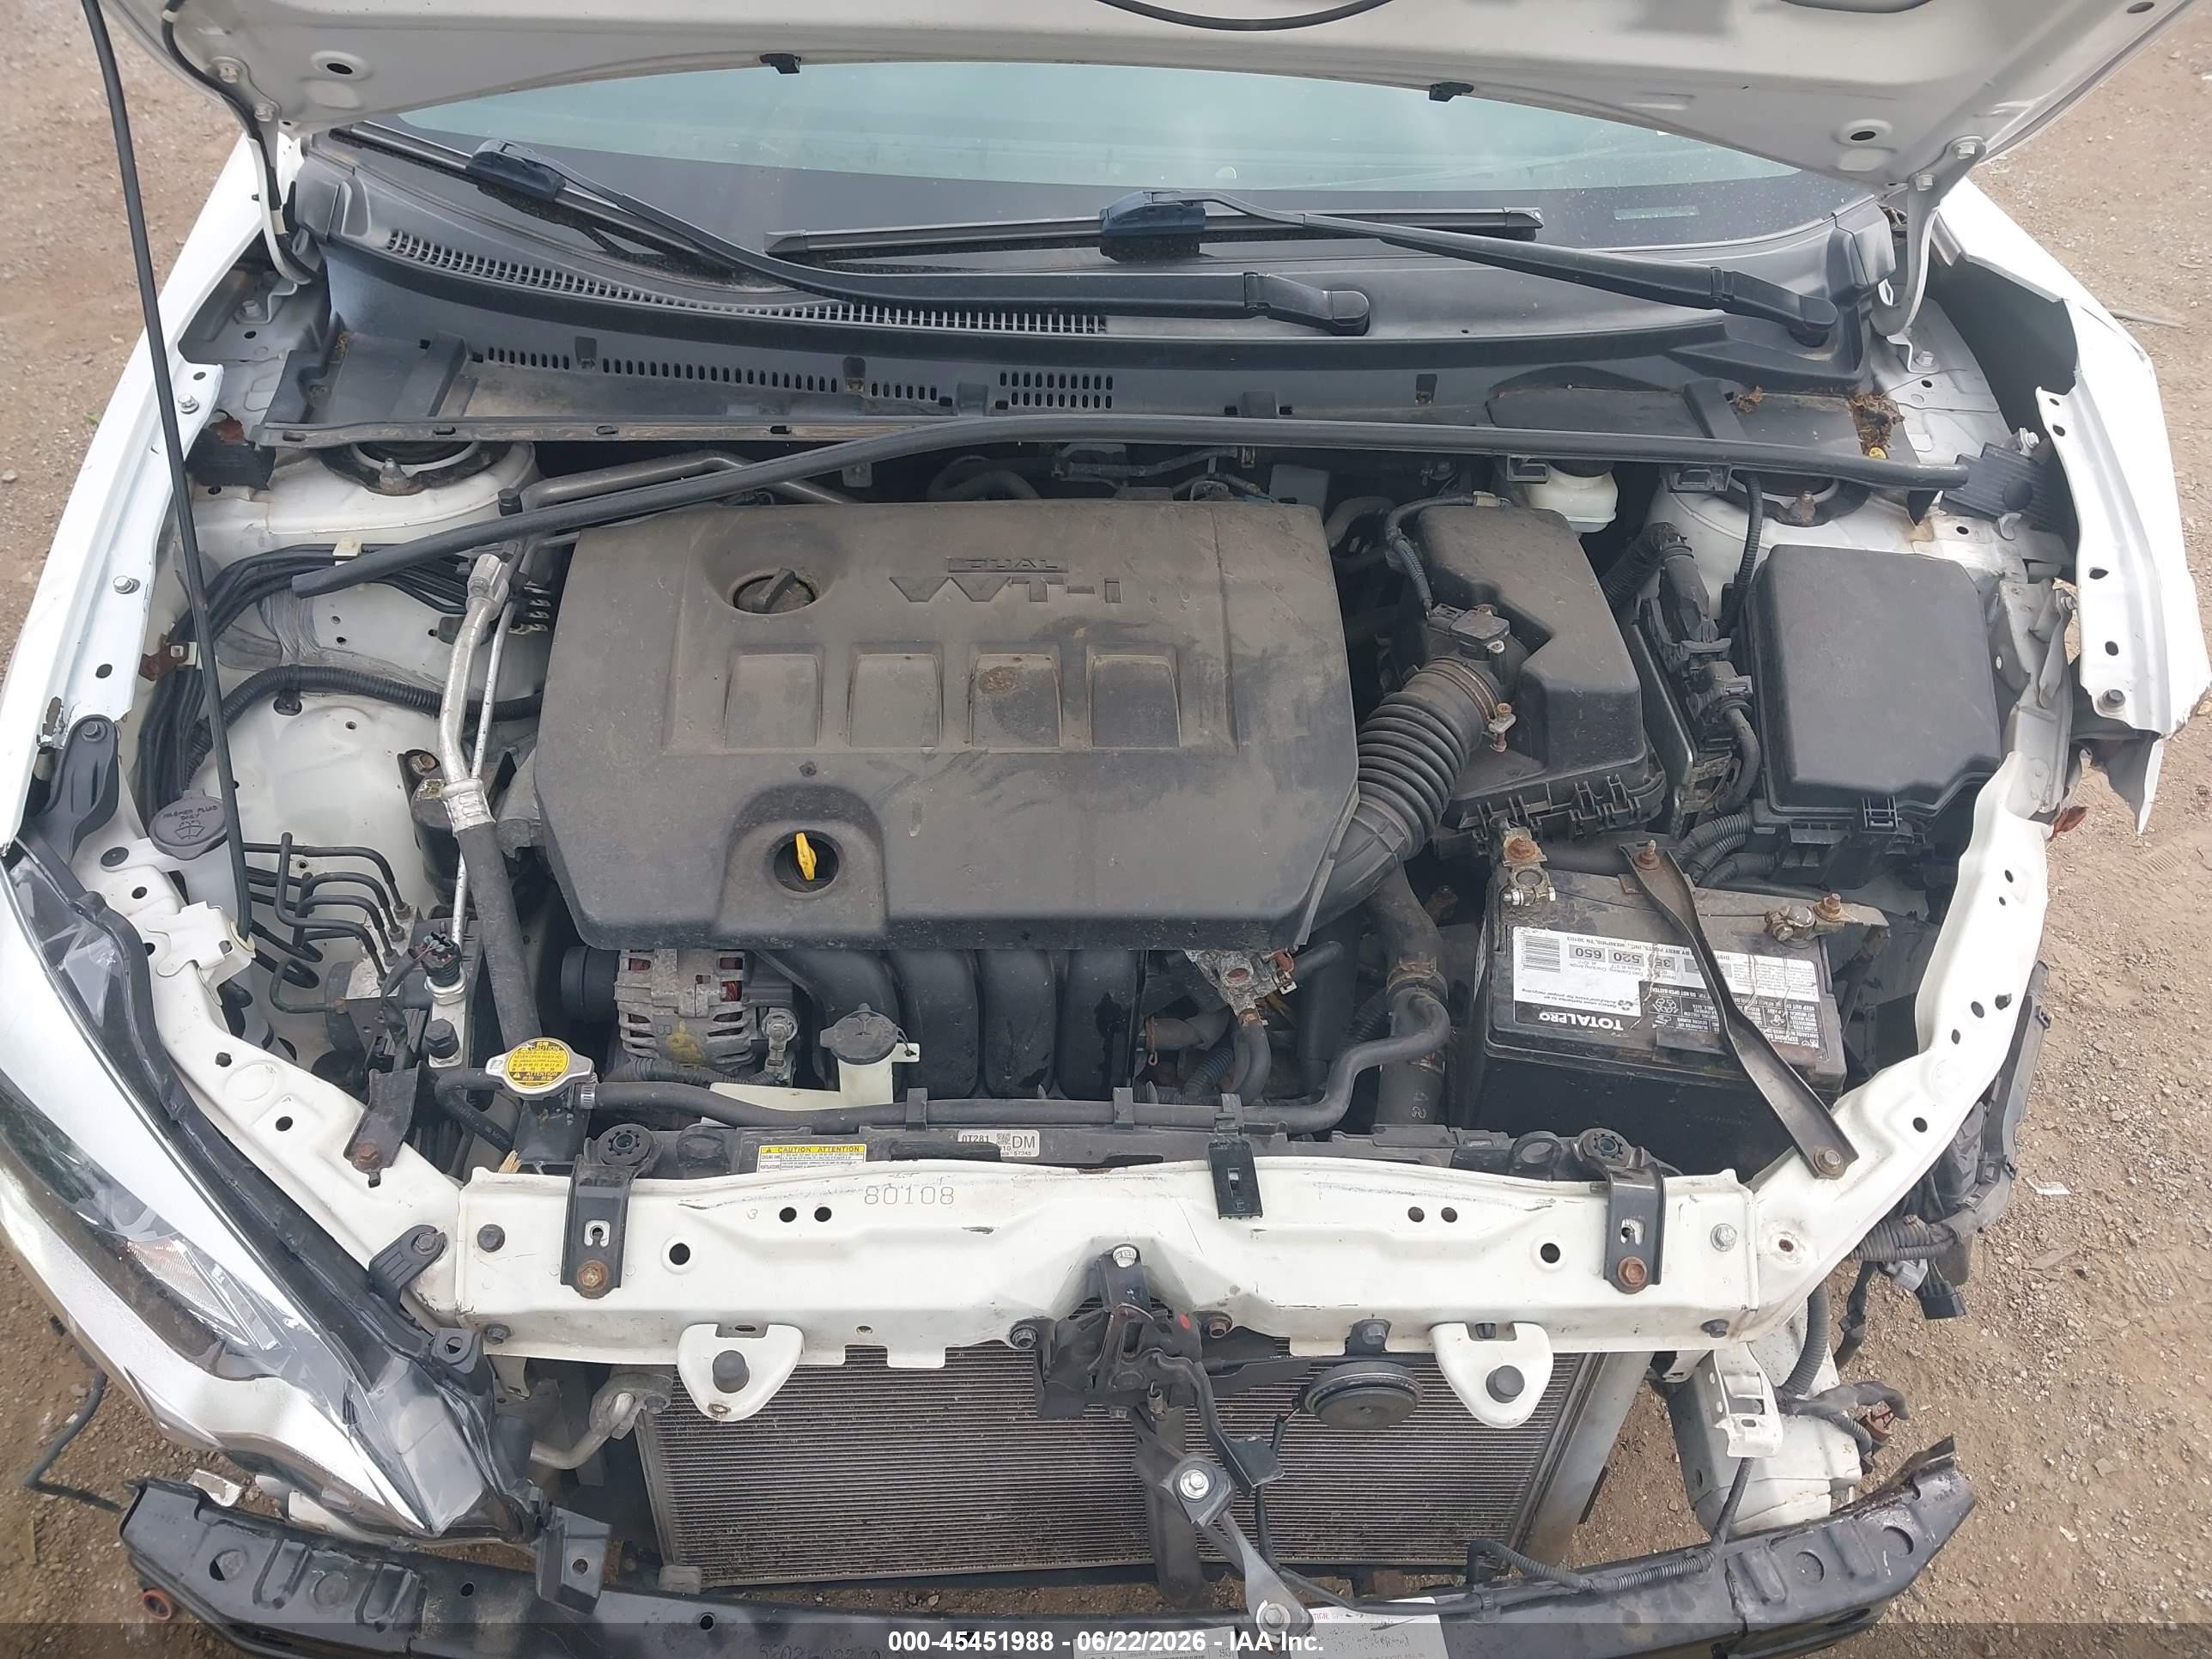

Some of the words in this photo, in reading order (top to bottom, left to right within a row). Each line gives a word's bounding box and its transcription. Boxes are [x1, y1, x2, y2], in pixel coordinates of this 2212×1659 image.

[964, 557, 1059, 569] DUAL
[163, 809, 193, 818] WASHER
[198, 805, 218, 813] FLUID
[180, 812, 199, 821] ONLY
[1575, 947, 1601, 958] 650
[1613, 951, 1641, 963] 520
[1538, 1012, 1623, 1030] TOTALPRO
[1012, 1135, 1035, 1148] DM
[865, 1186, 954, 1205] 80108
